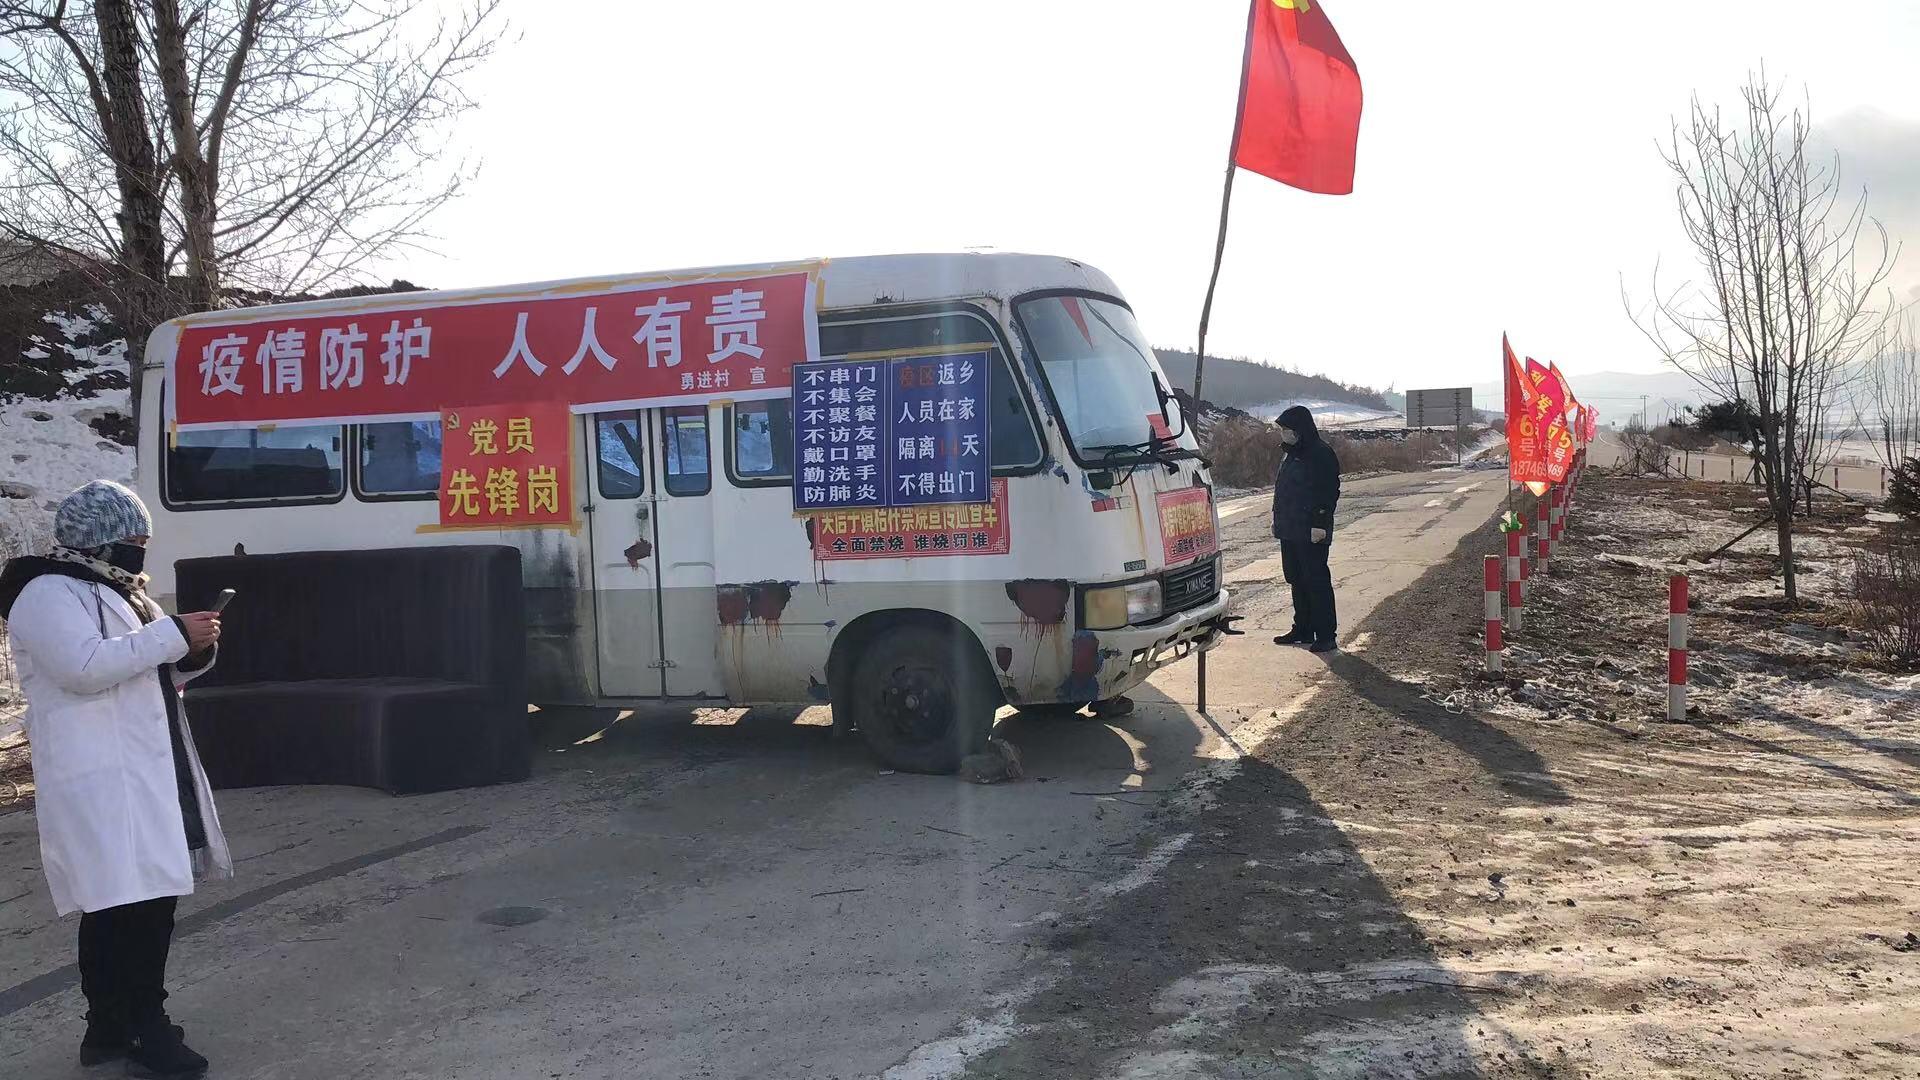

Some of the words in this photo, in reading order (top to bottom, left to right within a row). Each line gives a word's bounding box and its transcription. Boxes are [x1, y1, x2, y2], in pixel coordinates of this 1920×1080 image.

[198, 316, 433, 397] 疫情防护
[492, 288, 767, 380] 人人有责
[681, 368, 730, 391] 勇进村
[749, 366, 767, 385] 宣
[802, 365, 877, 386] 不串门
[803, 386, 877, 405] 不集会
[803, 405, 877, 425] 不聚餐
[898, 397, 976, 424] 人员在家
[467, 417, 535, 456] 党员
[803, 425, 877, 444] 不访友
[803, 444, 877, 464] 戴口罩
[803, 464, 877, 484] 勤洗手
[898, 470, 976, 496] 不得出门
[447, 464, 559, 518] 先锋岗
[803, 484, 877, 504] 防肺炎
[831, 535, 905, 553] 全面禁烧
[913, 532, 989, 551] 谁烧罚谁
